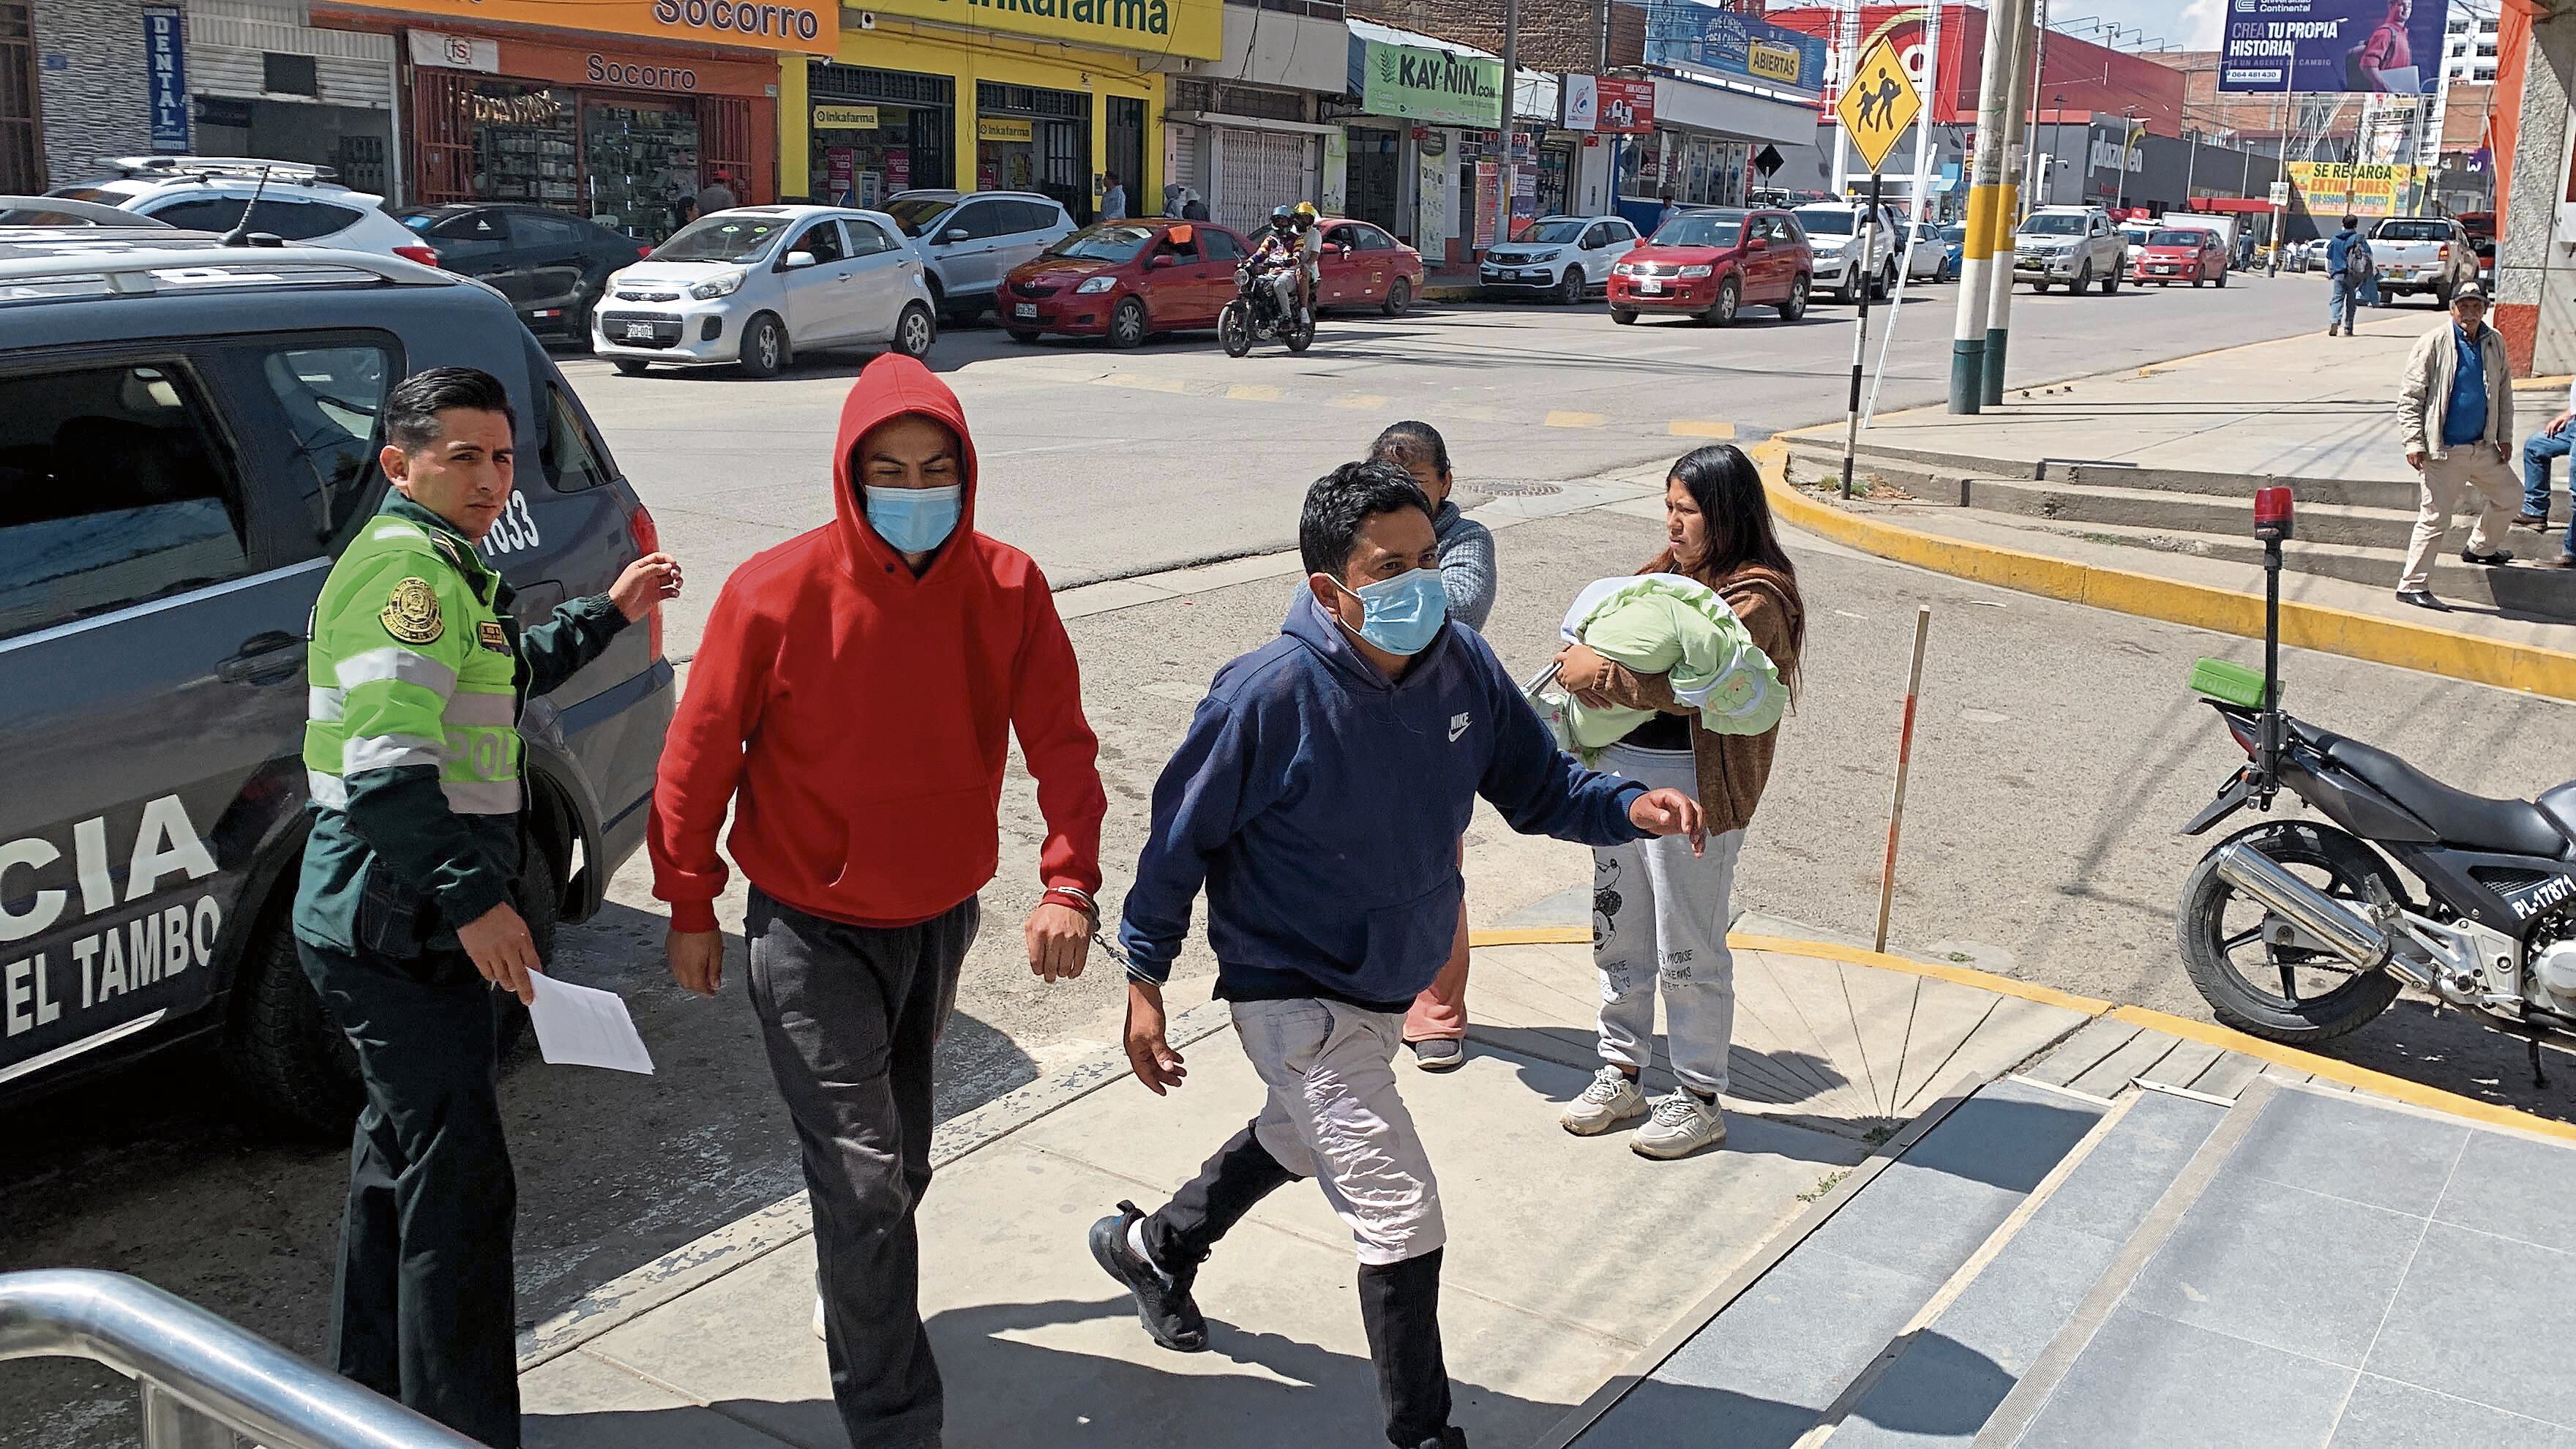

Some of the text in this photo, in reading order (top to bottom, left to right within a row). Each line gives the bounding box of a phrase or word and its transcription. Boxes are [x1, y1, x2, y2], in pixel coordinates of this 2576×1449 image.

[2260, 4, 2311, 12] Continental
[655, 0, 819, 40] Socorro
[2233, 22, 2338, 39] CREA TU PROPIA
[2229, 40, 2293, 56] HISTORIA
[153, 16, 176, 126] DENTAL
[586, 53, 696, 90] Socorro
[1753, 52, 1795, 76] ABIERTAS
[826, 111, 875, 123] Inkafarma
[988, 124, 1030, 137] Inkafarma
[2314, 163, 2329, 178] SE
[2311, 178, 2390, 195] EXTINORES
[1451, 711, 1469, 730] NIKE
[0, 794, 219, 941] CIA
[2512, 874, 2576, 920] PL-17871
[5, 894, 221, 1037] EL TAMBO
[1667, 948, 1693, 965] MOUSE
